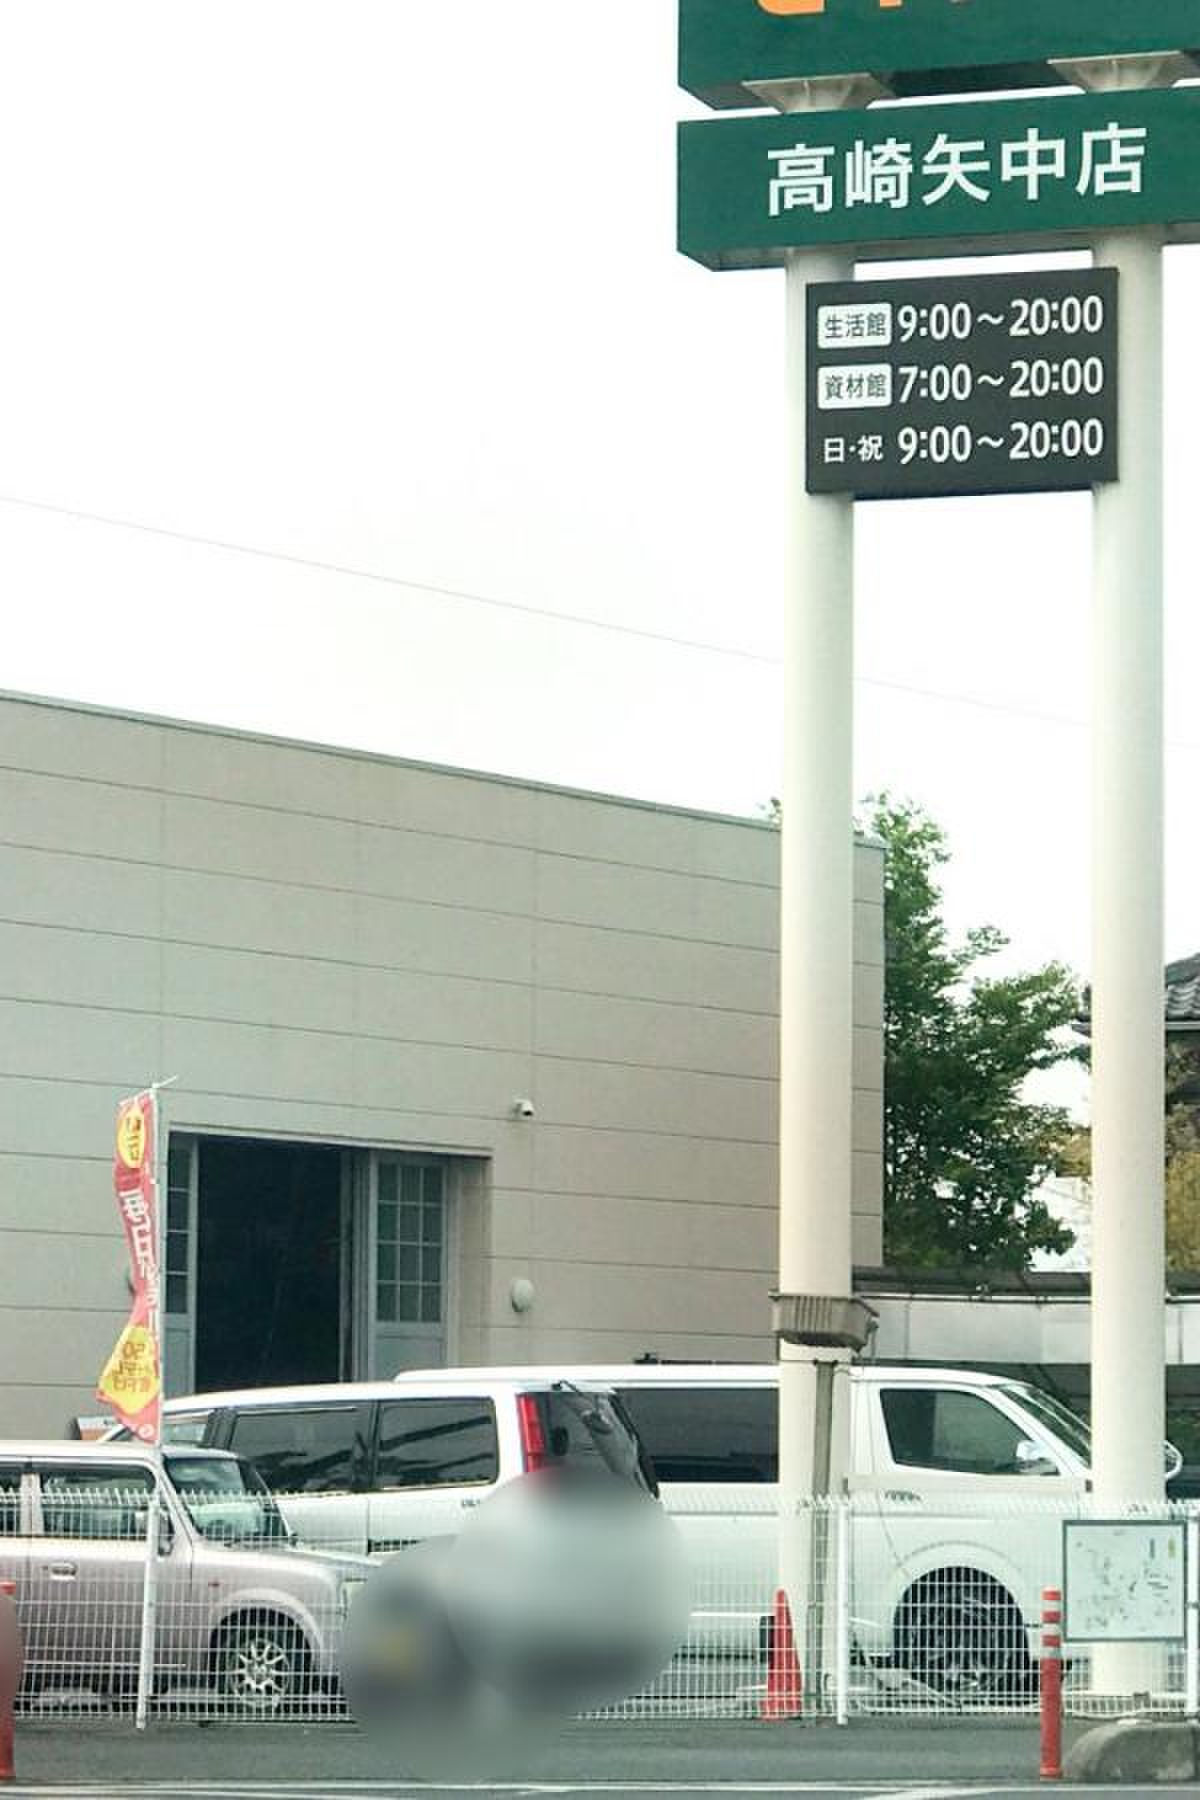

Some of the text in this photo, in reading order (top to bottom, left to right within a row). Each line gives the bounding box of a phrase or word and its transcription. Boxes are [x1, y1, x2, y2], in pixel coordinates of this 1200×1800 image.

[767, 122, 1147, 216] 高崎矢中店
[824, 310, 887, 340] 生活館
[824, 372, 887, 400] 資材館
